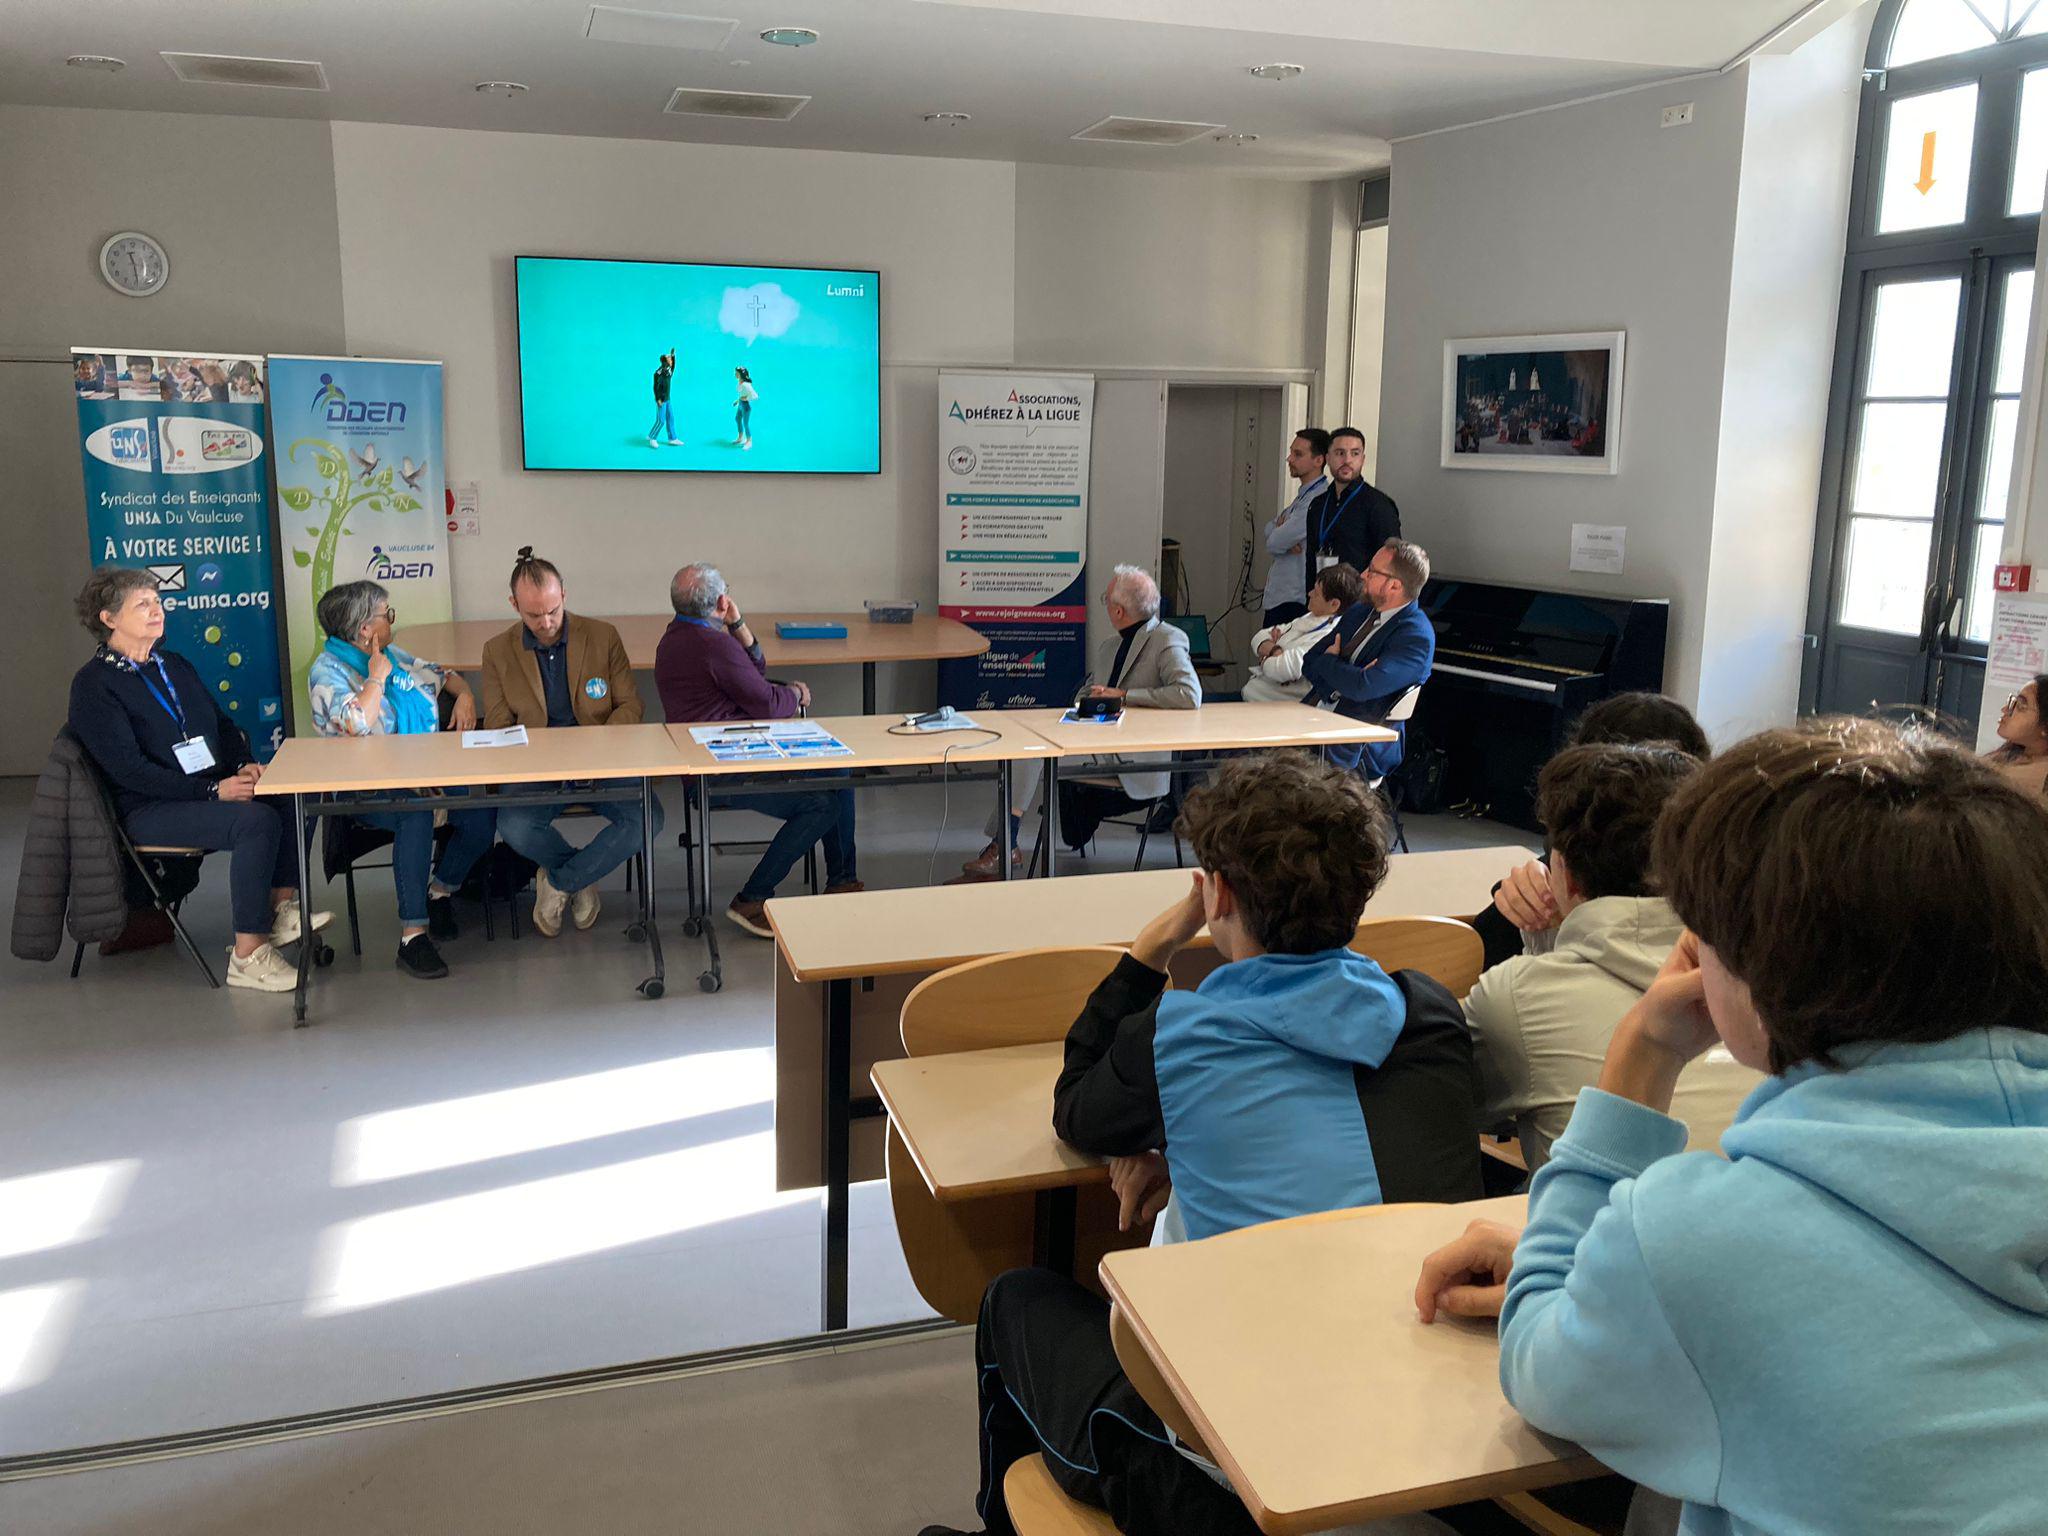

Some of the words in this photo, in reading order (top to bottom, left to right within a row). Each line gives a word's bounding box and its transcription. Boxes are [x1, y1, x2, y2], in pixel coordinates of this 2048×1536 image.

[826, 283, 865, 297] Lumni
[1008, 389, 1082, 407] ASSOCIATIONS,
[326, 400, 407, 423] DDEN
[948, 400, 1013, 424] ADHÉREZ
[1016, 406, 1025, 421] À
[1028, 409, 1043, 421] LA
[1046, 409, 1080, 421] LIGUE
[100, 491, 157, 508] Syndicat
[162, 490, 184, 505] des
[189, 489, 261, 507] Enseignants
[124, 511, 161, 526] UNSA
[166, 510, 183, 524] Du
[104, 536, 117, 560] À
[122, 538, 177, 559] VOTRE
[183, 536, 250, 556] SERVICE
[376, 563, 434, 580] DDEN
[161, 591, 270, 612] e-unsa.org
[986, 651, 1009, 662] ligue
[1009, 652, 1019, 660] de
